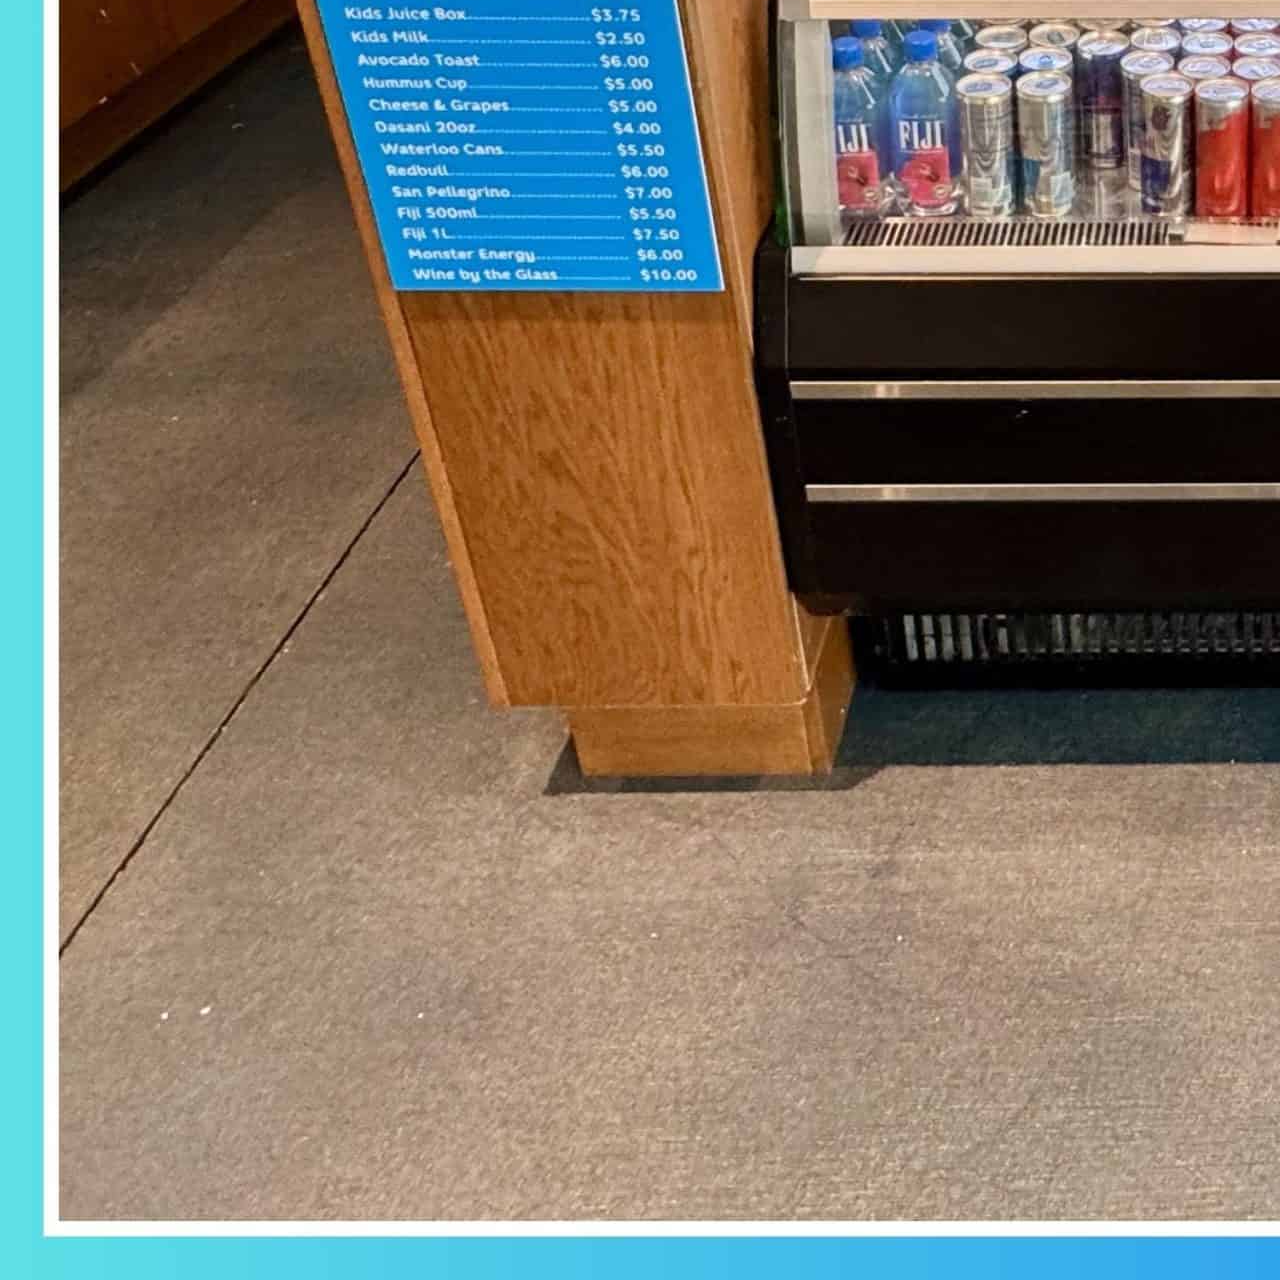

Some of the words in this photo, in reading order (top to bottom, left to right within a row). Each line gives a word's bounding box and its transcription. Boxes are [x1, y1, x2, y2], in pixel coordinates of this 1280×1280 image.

[344, 6, 383, 21] Kids
[387, 7, 430, 20] Juice
[433, 7, 467, 21] Box
[591, 7, 641, 22] $3.75
[351, 31, 389, 43] Kids
[392, 31, 430, 44] Milk
[595, 31, 645, 45] $2.50
[357, 53, 430, 66] Avocado
[434, 53, 481, 67] Toast
[599, 54, 649, 69] $6.00
[363, 77, 433, 89] Hummus
[435, 77, 467, 91] Cup
[604, 77, 654, 91] $5.00
[368, 98, 429, 111] Cheese
[433, 99, 446, 111] &
[450, 99, 510, 114] Grapes
[608, 99, 657, 113] $5.00
[374, 120, 431, 133] Dasani
[612, 121, 661, 135] $4.00
[899, 120, 943, 149] FIJI
[837, 122, 869, 152] IJI
[380, 143, 460, 155] Waterloo
[463, 143, 505, 155] Cans
[617, 143, 665, 157] $5.50
[385, 164, 449, 177] Redbull
[621, 165, 669, 179] $6.00
[391, 185, 422, 198] San
[426, 185, 511, 201] Pellegrino
[624, 186, 673, 200] $7.00
[397, 207, 422, 221] Fiji
[629, 207, 677, 221] $5.50
[402, 227, 427, 241] Fiji
[632, 227, 680, 241] $7.50
[407, 248, 474, 260] Monster
[478, 248, 537, 263] Energy
[637, 248, 684, 262] $6.00
[412, 268, 455, 280] Wine
[458, 269, 481, 284] by
[483, 268, 511, 281] the
[514, 268, 559, 281] Glass
[639, 268, 698, 282] $10.00
